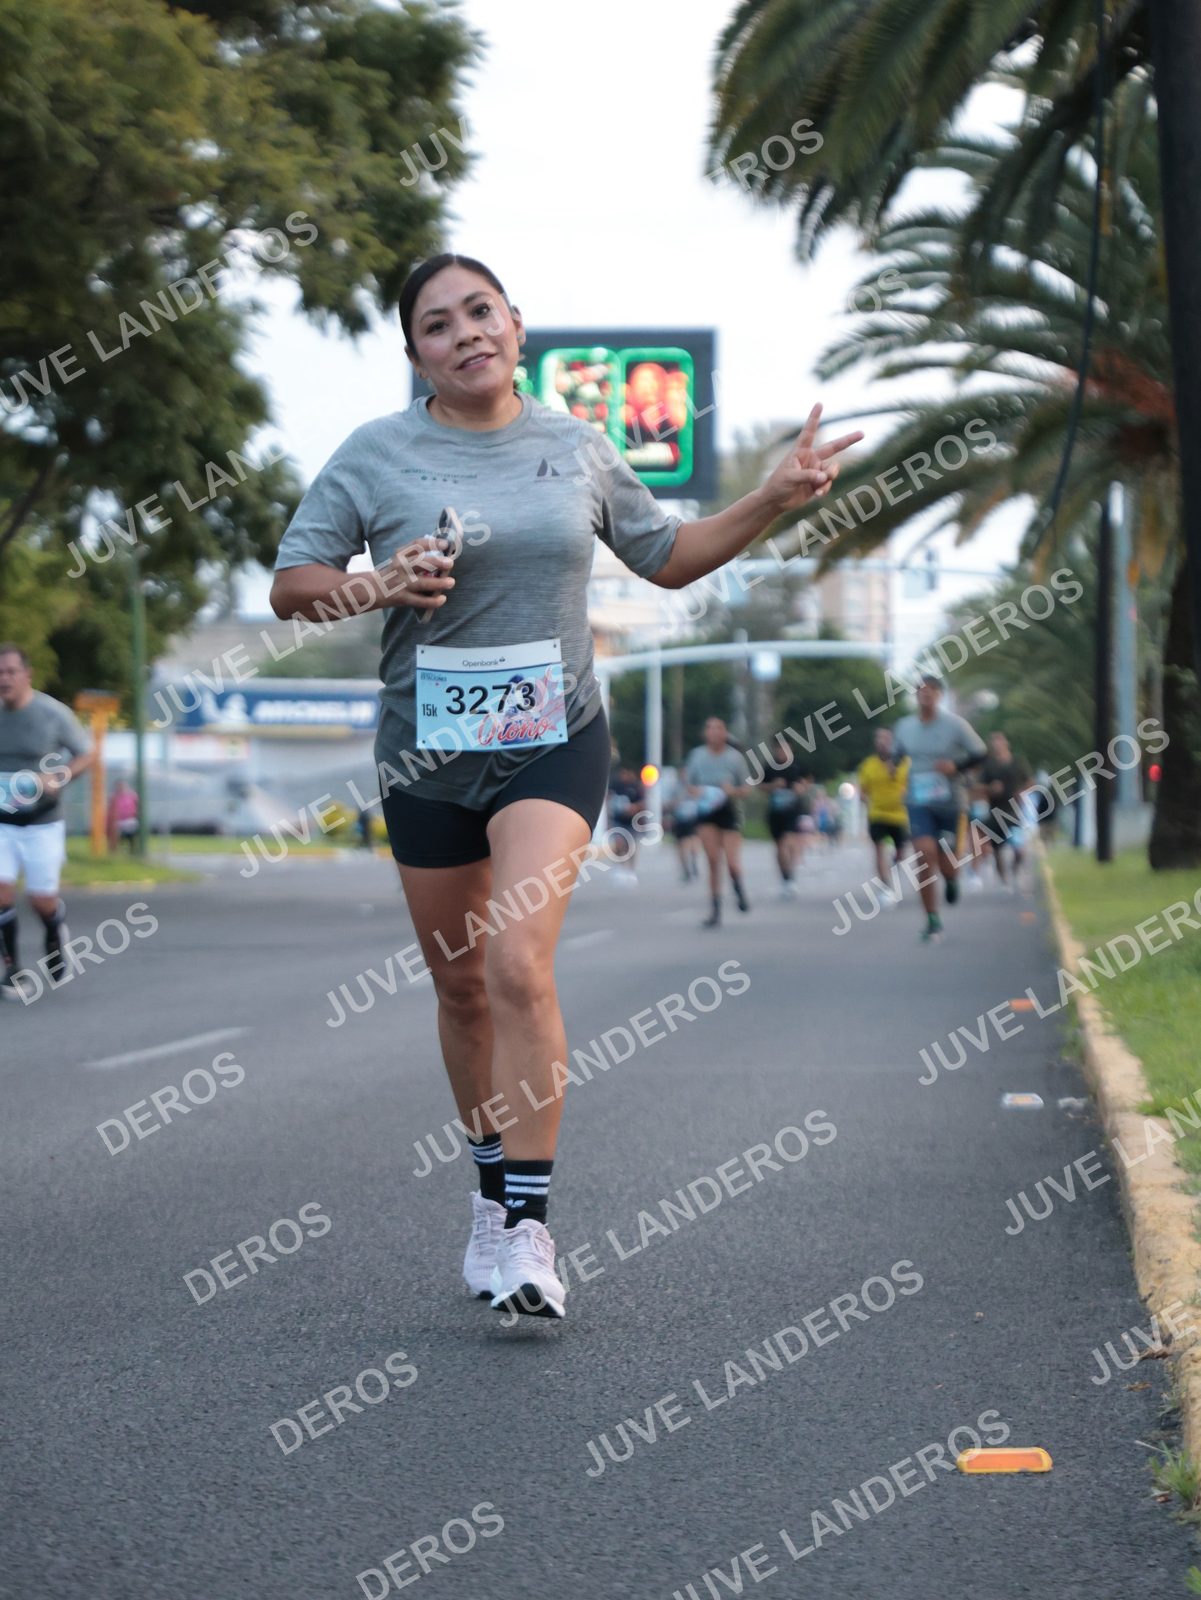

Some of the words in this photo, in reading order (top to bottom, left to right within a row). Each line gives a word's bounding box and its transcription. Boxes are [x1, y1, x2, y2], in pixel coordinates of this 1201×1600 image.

[462, 659, 498, 667] Openbank
[446, 682, 536, 714] 3273
[422, 703, 438, 717] 15k
